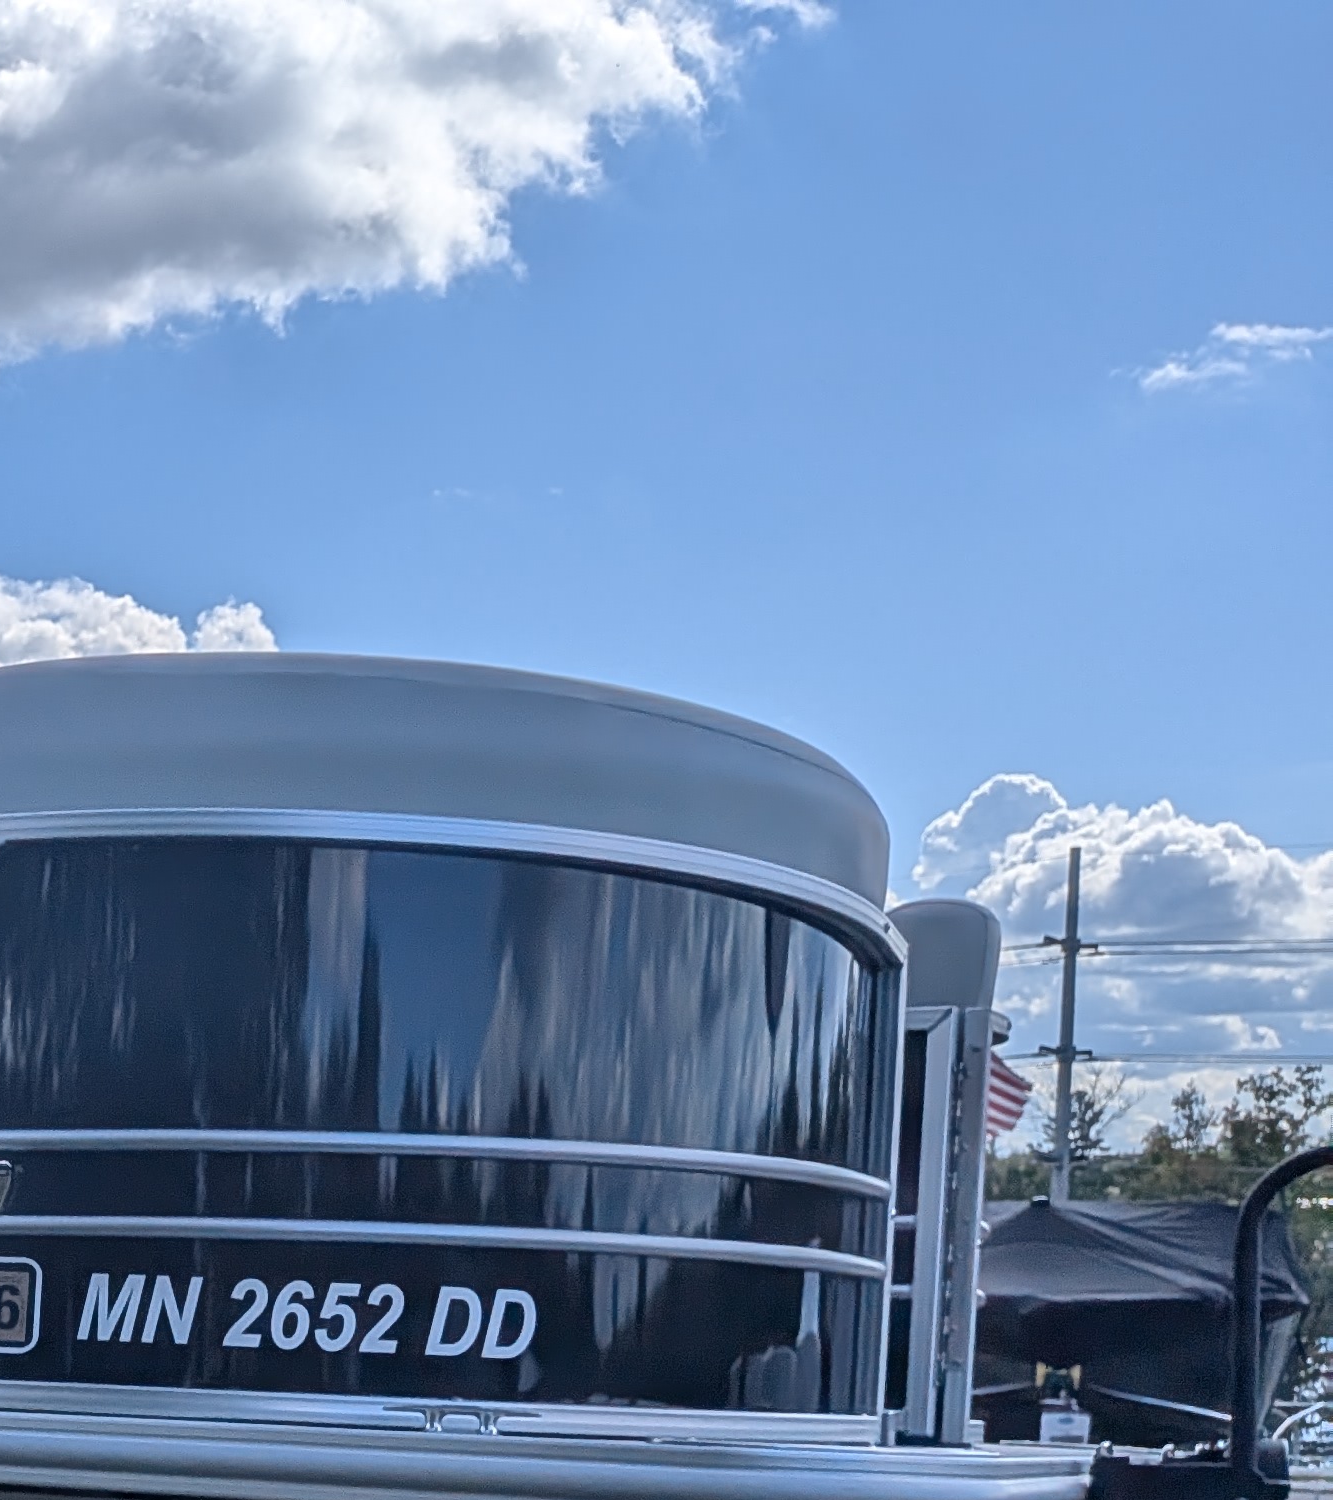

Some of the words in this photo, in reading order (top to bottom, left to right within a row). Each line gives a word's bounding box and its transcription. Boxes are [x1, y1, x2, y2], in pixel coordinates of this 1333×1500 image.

[76, 1272, 204, 1344] MN
[222, 1278, 406, 1354] 2652
[424, 1286, 538, 1360] DD
